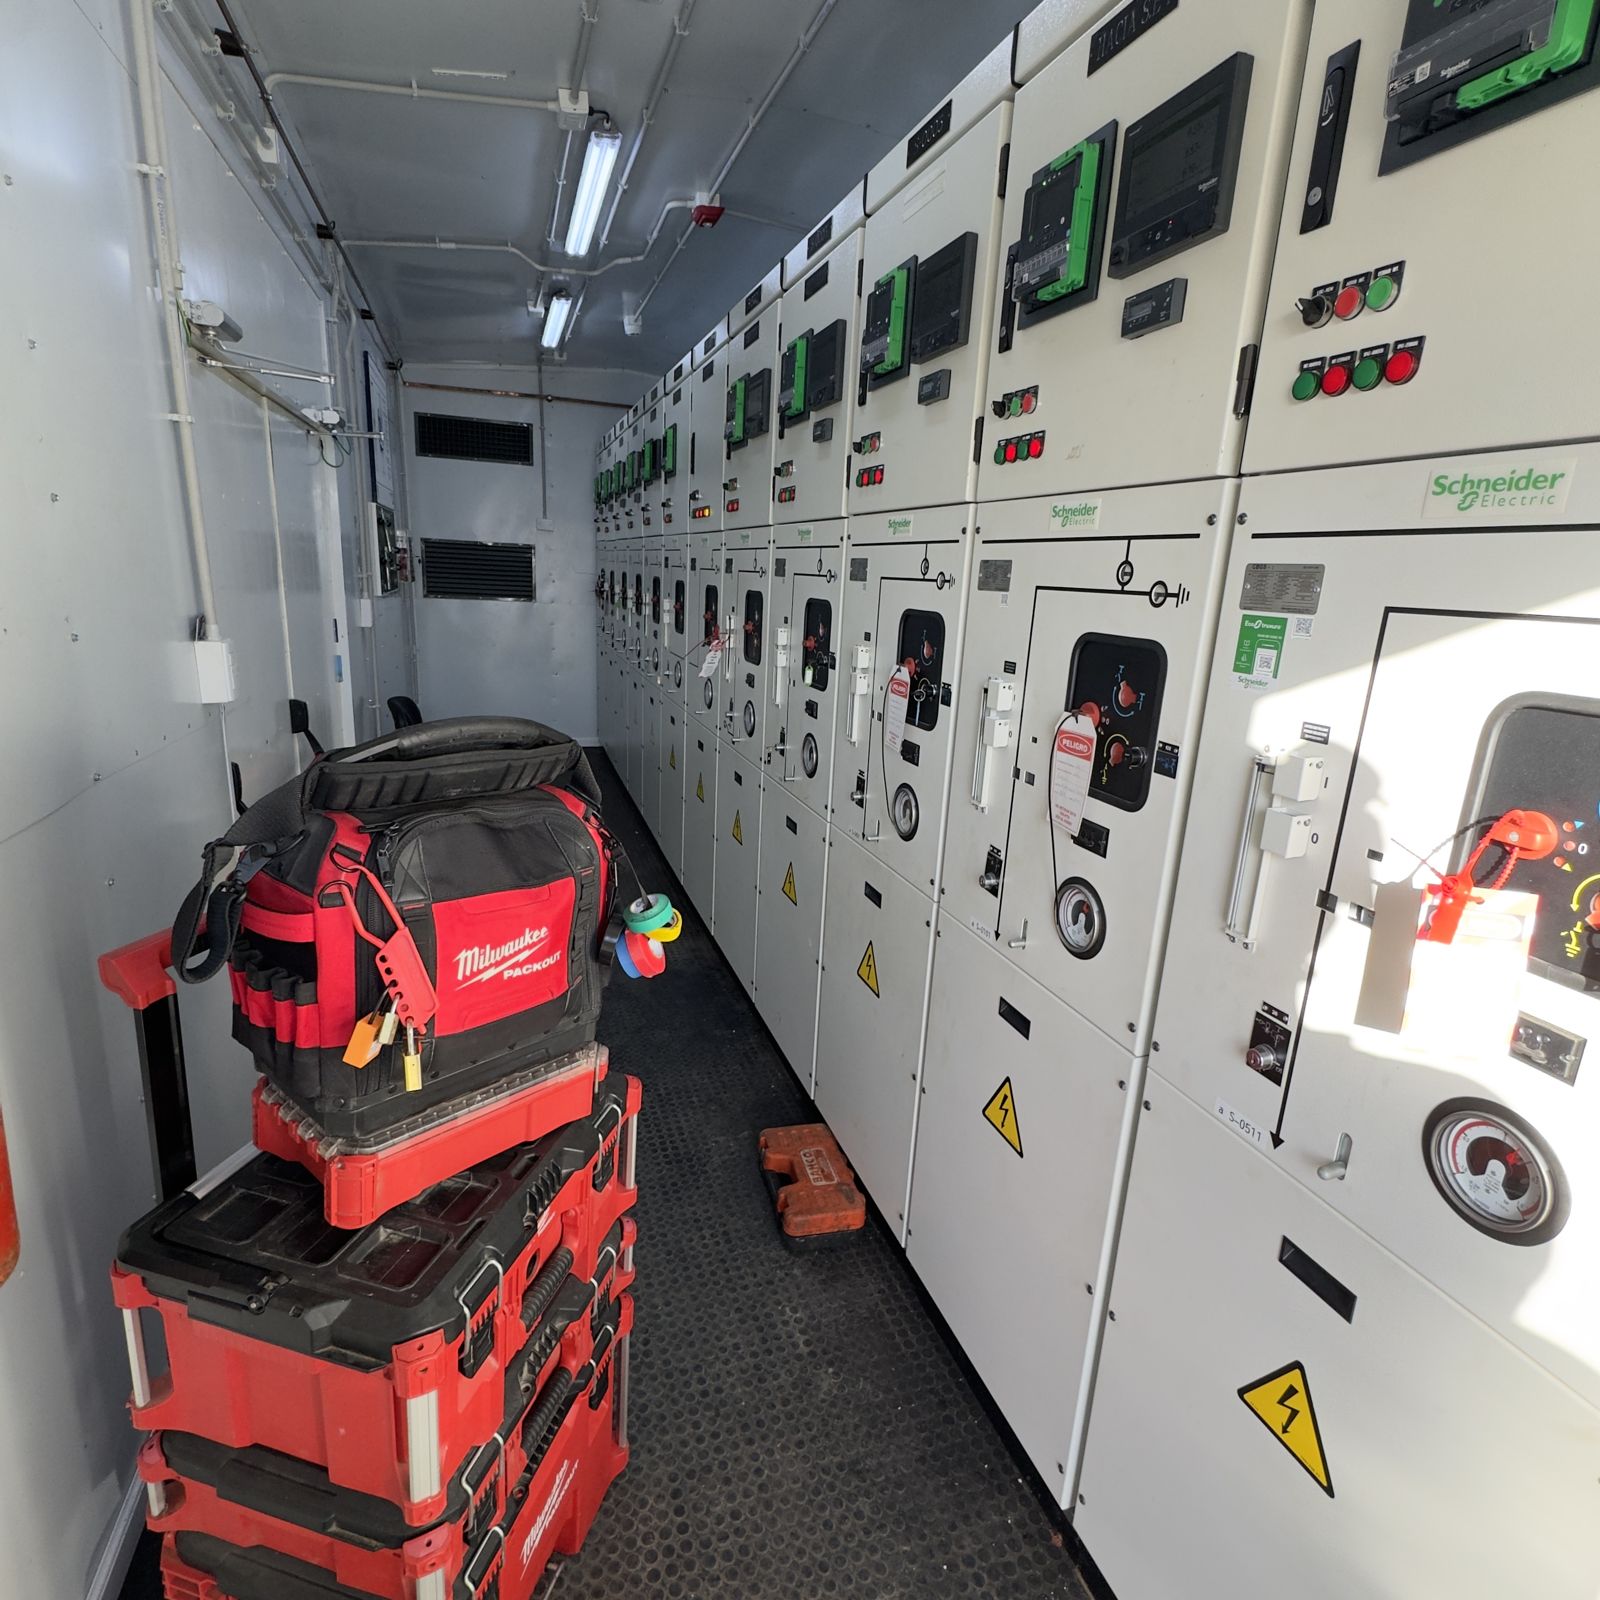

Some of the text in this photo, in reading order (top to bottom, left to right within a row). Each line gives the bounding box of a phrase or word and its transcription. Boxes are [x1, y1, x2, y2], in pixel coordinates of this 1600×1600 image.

[1432, 468, 1565, 496] Schneider
[1052, 503, 1098, 518] Schneider
[1481, 494, 1556, 508] Electric
[1062, 738, 1088, 753] PELIGRO
[453, 926, 549, 981] Milwaukee
[503, 950, 562, 981] PACKOUT
[1218, 1106, 1263, 1143] a S-0511
[803, 1150, 824, 1184] BAHCO
[520, 1459, 569, 1565] Milwaukee
